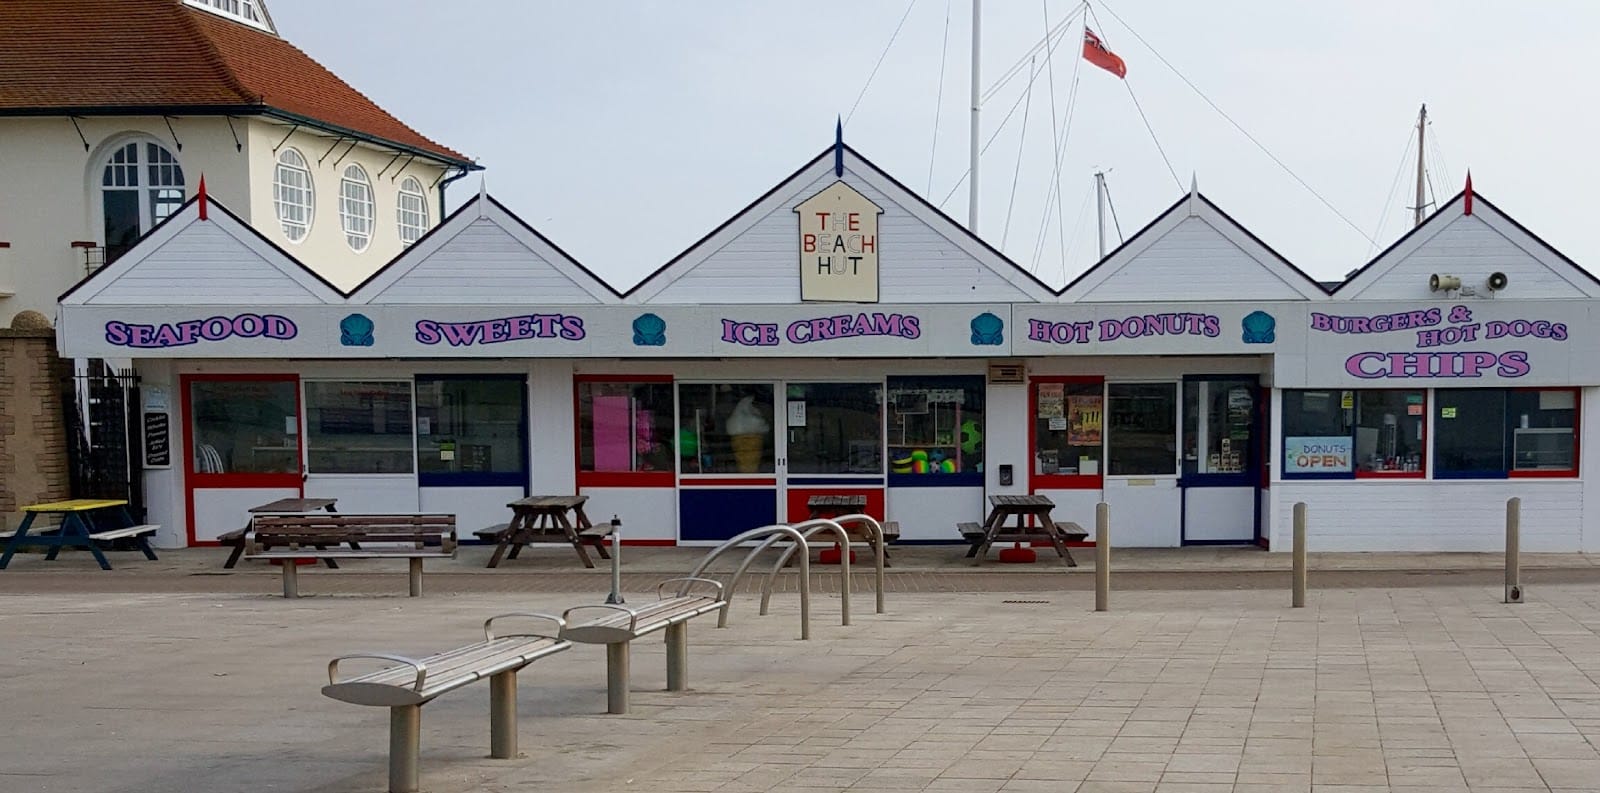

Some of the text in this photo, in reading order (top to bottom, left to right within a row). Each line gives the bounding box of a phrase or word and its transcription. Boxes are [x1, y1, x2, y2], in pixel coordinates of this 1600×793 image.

[816, 212, 859, 231] THE
[804, 233, 874, 253] BEACH
[818, 256, 863, 275] HUT
[104, 313, 298, 348] SEAFOOD
[415, 313, 585, 346] SWEETS
[721, 313, 920, 346] ICE CREAMS
[1028, 313, 1220, 345] HOT DONUTS
[1311, 305, 1472, 334] BURGERS &
[1416, 320, 1568, 348] HOT DOGS
[1345, 351, 1531, 378] CHIPS
[1296, 454, 1347, 468] OPEN
[1303, 444, 1346, 454] DONUTS
